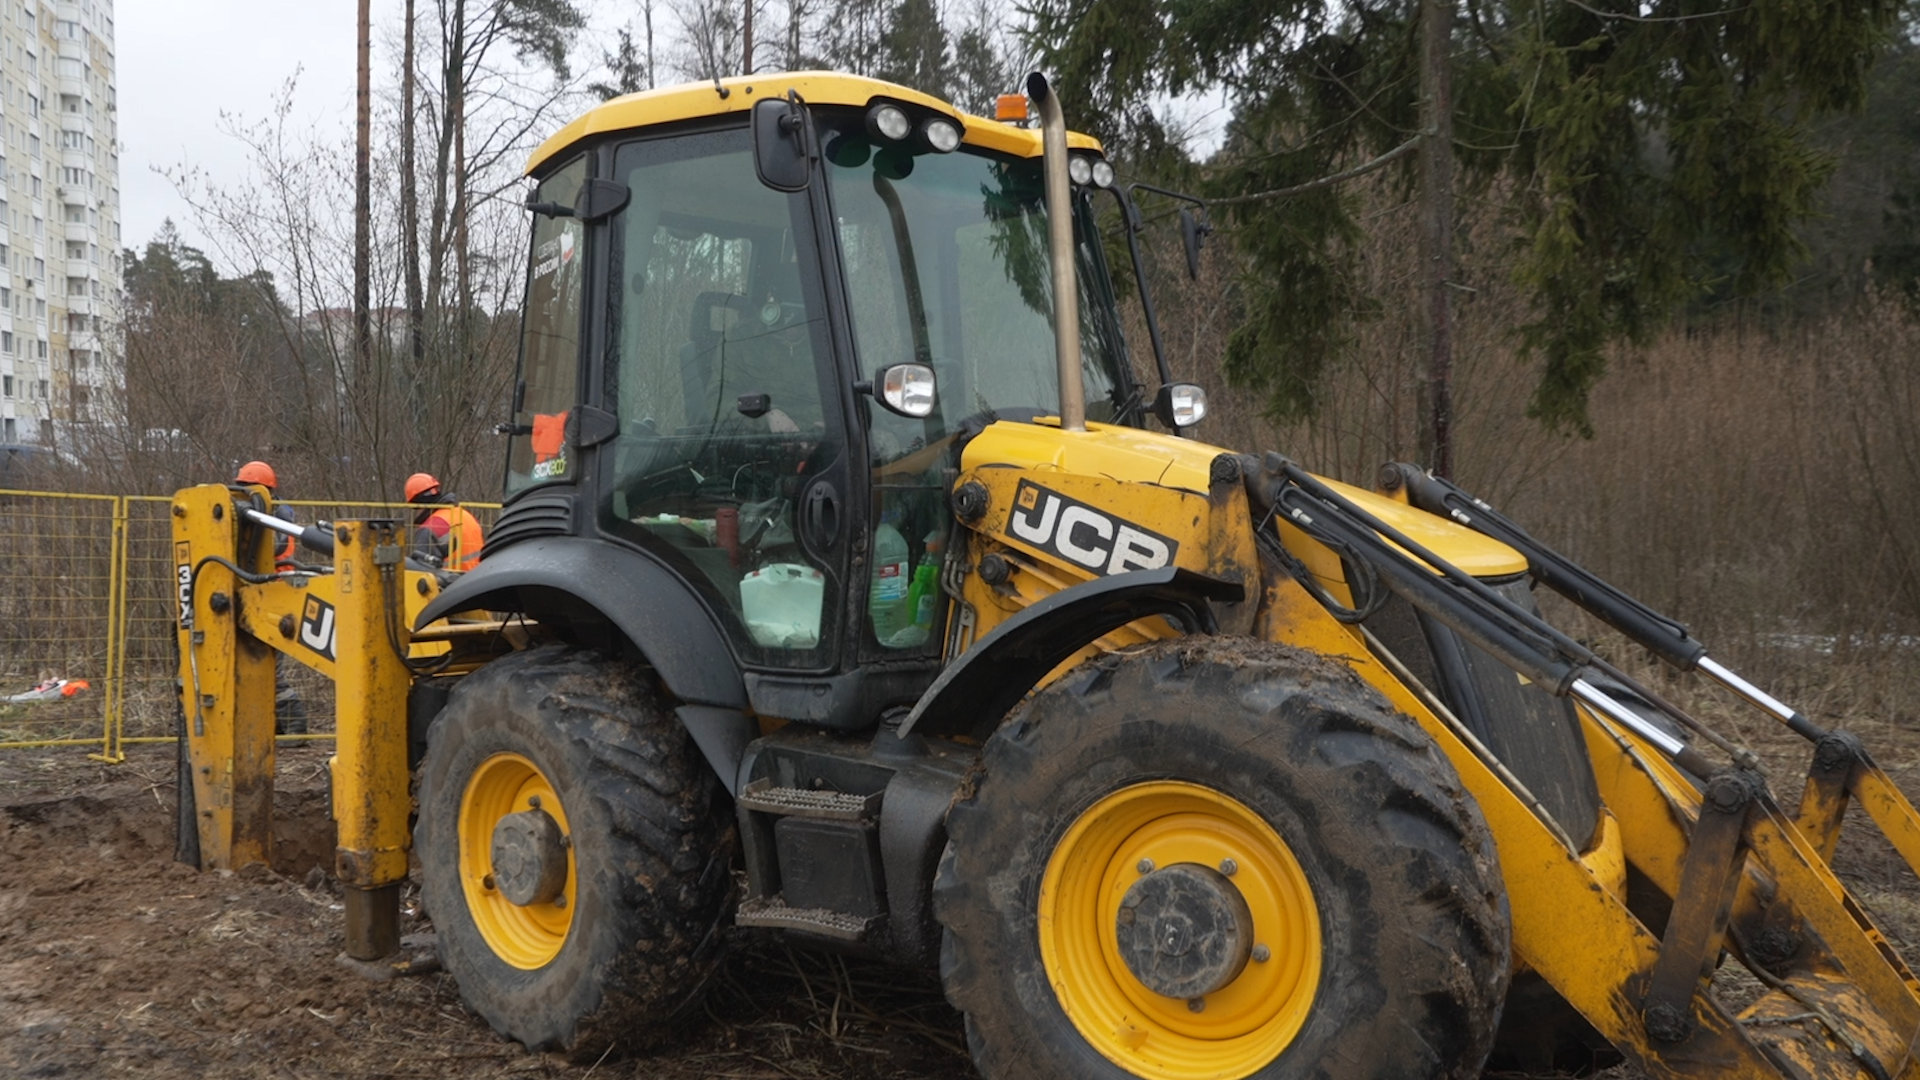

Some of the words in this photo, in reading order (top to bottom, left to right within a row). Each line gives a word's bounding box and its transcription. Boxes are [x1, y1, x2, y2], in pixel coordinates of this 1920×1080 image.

[1011, 494, 1169, 576] JCB
[178, 565, 192, 619] 3CX
[301, 607, 336, 658] J
